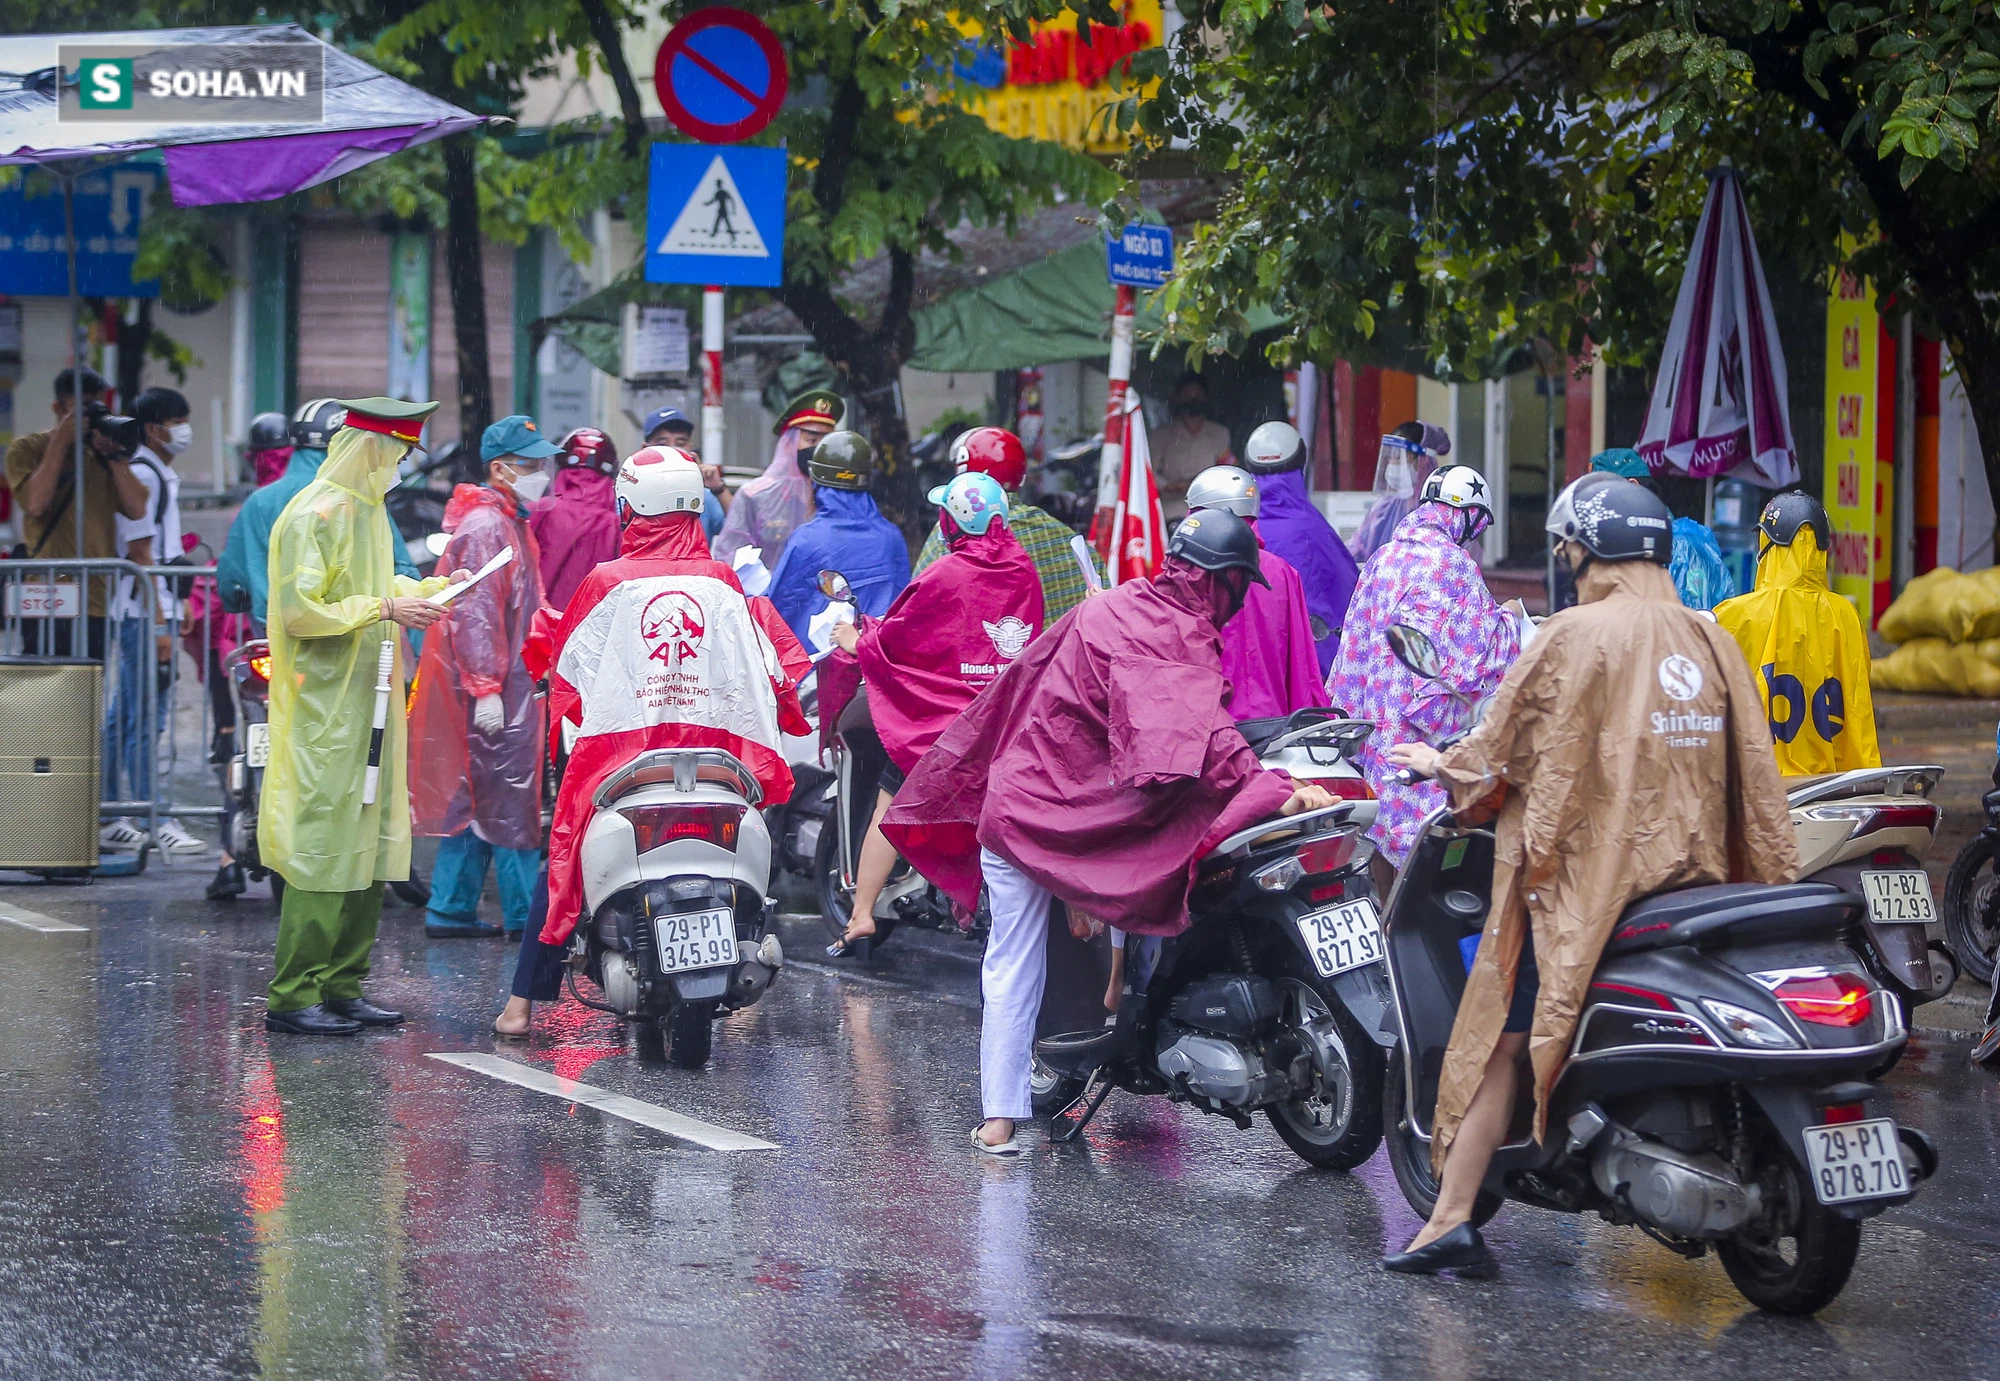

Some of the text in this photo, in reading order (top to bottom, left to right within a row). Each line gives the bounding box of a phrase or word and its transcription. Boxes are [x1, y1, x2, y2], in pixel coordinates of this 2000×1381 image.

[960, 663, 995, 674] Honda
[1761, 662, 1845, 745] be
[1873, 874, 1921, 896] 17-B2
[1310, 905, 1368, 943] 29-P1
[1872, 897, 1932, 919] 472.93
[667, 913, 722, 943] 29-P1
[664, 938, 733, 969] 345.99
[1316, 930, 1383, 972] 827.97
[1819, 1125, 1885, 1163] 29-P1
[1821, 1159, 1901, 1198] 878.70
